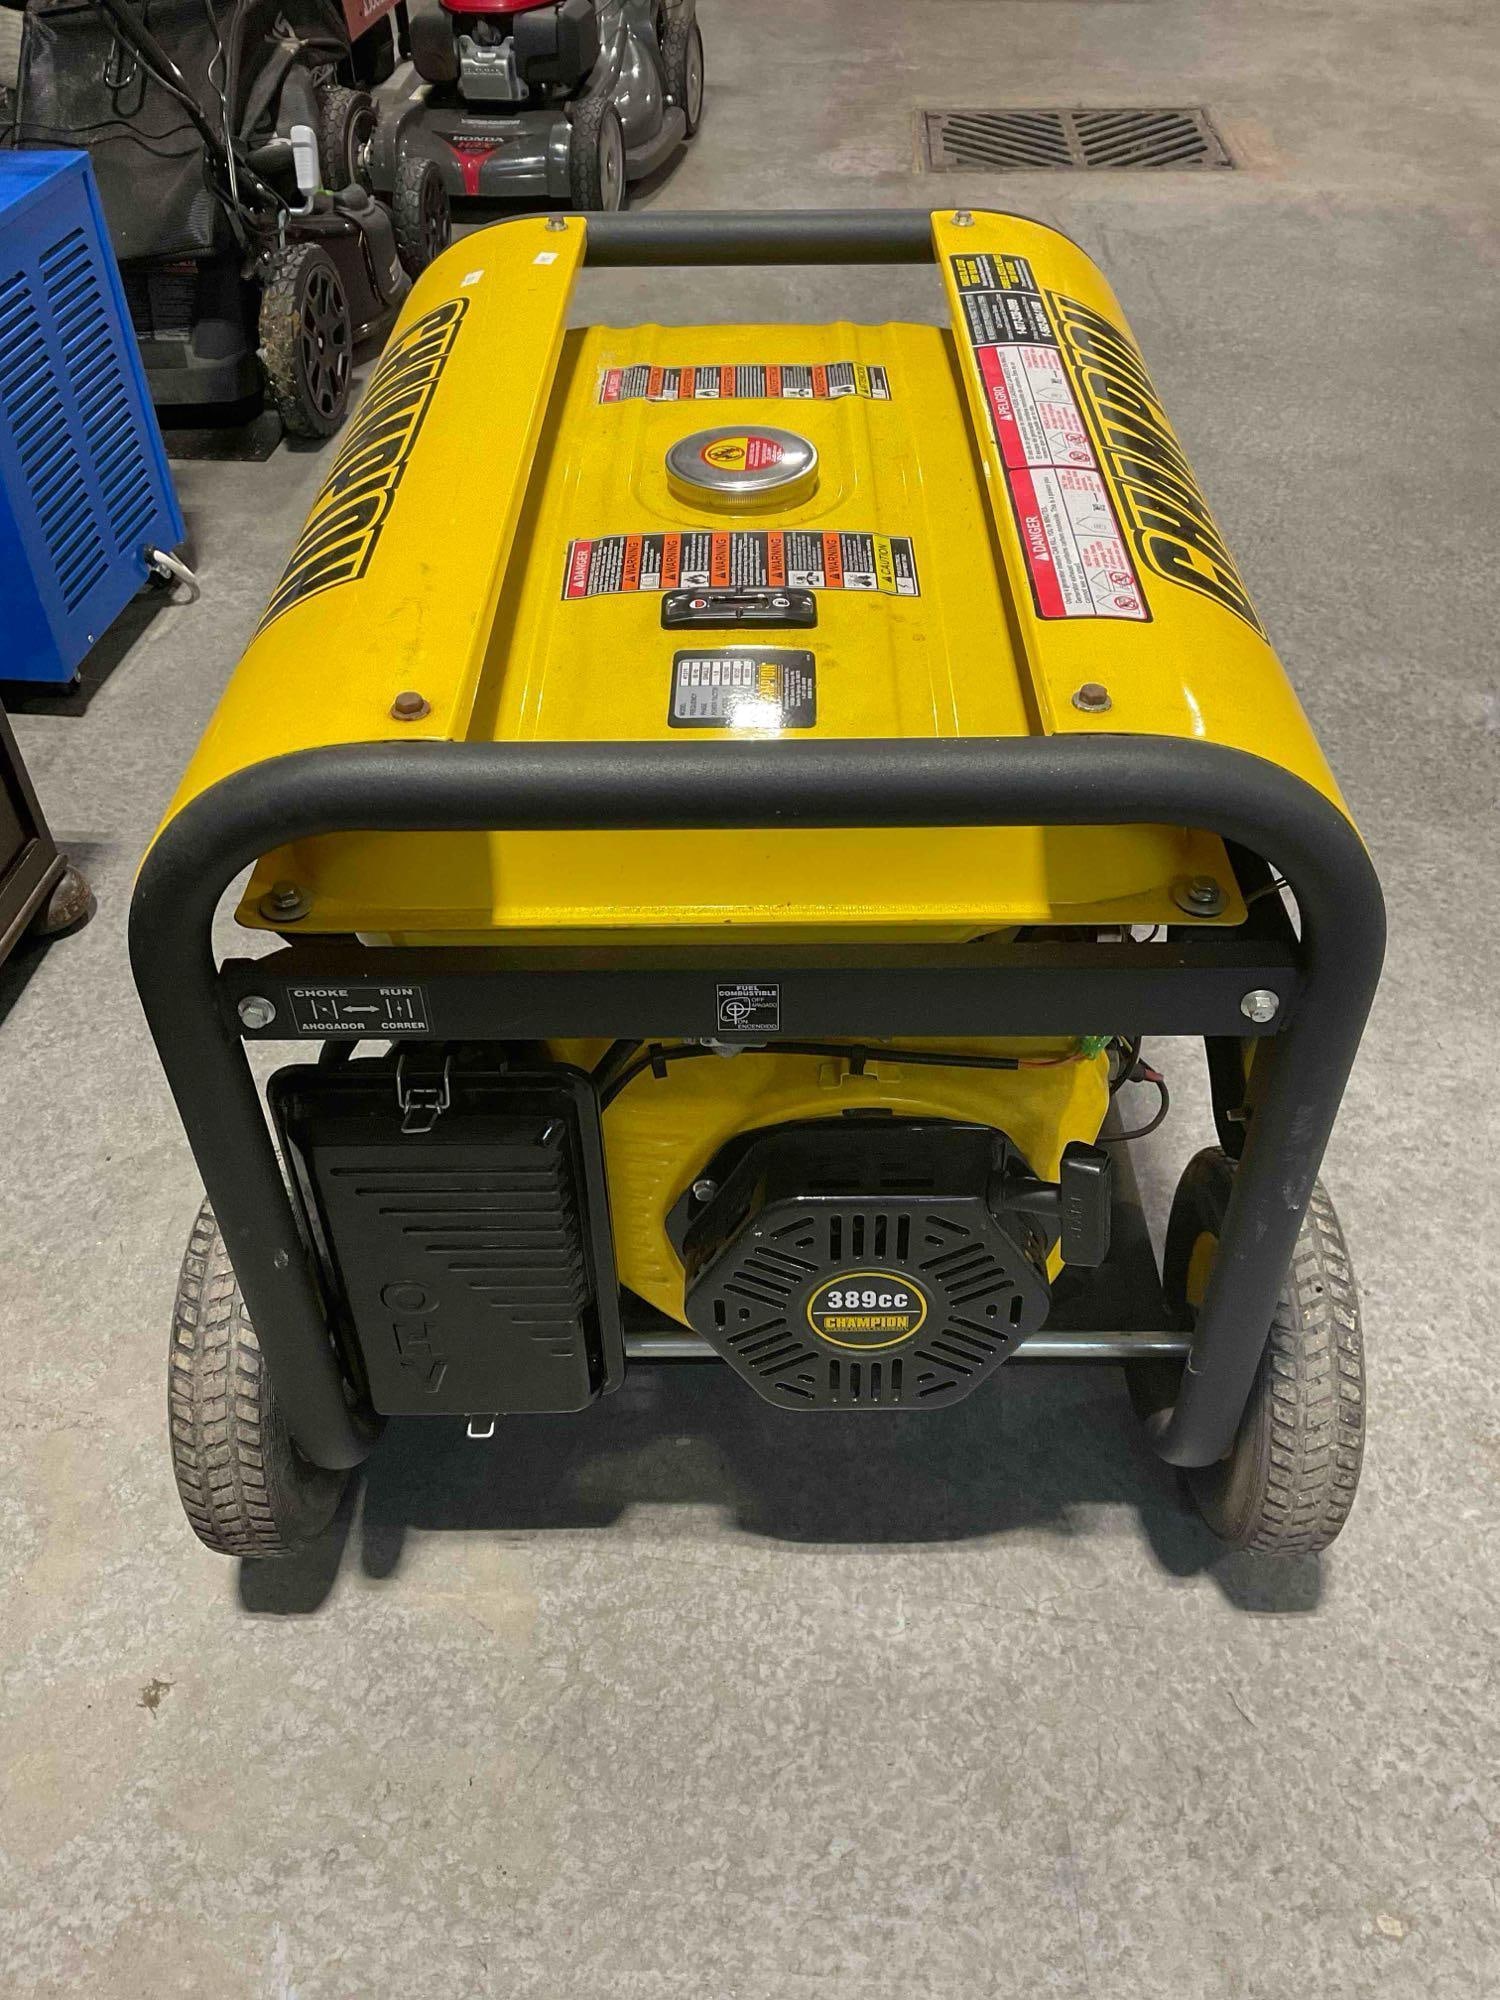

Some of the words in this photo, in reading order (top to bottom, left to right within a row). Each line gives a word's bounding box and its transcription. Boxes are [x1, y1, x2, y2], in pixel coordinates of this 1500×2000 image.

[993, 386, 1009, 414] PELIGRO
[1026, 516, 1046, 556] DANGER
[575, 550, 588, 580] DANGER
[627, 541, 639, 573] WARNING
[666, 539, 678, 573] WARNING
[715, 538, 727, 572] WARNING
[771, 538, 781, 572] WARNING
[827, 539, 838, 573] WARNING
[878, 544, 891, 573] CAUTION
[294, 989, 349, 997] CHOKE
[380, 988, 413, 996] RUN
[302, 1022, 366, 1030] AHOGADOR
[381, 1022, 426, 1030] CORRER
[827, 1290, 909, 1309] 389cc
[824, 1315, 909, 1329] CHAMPION
